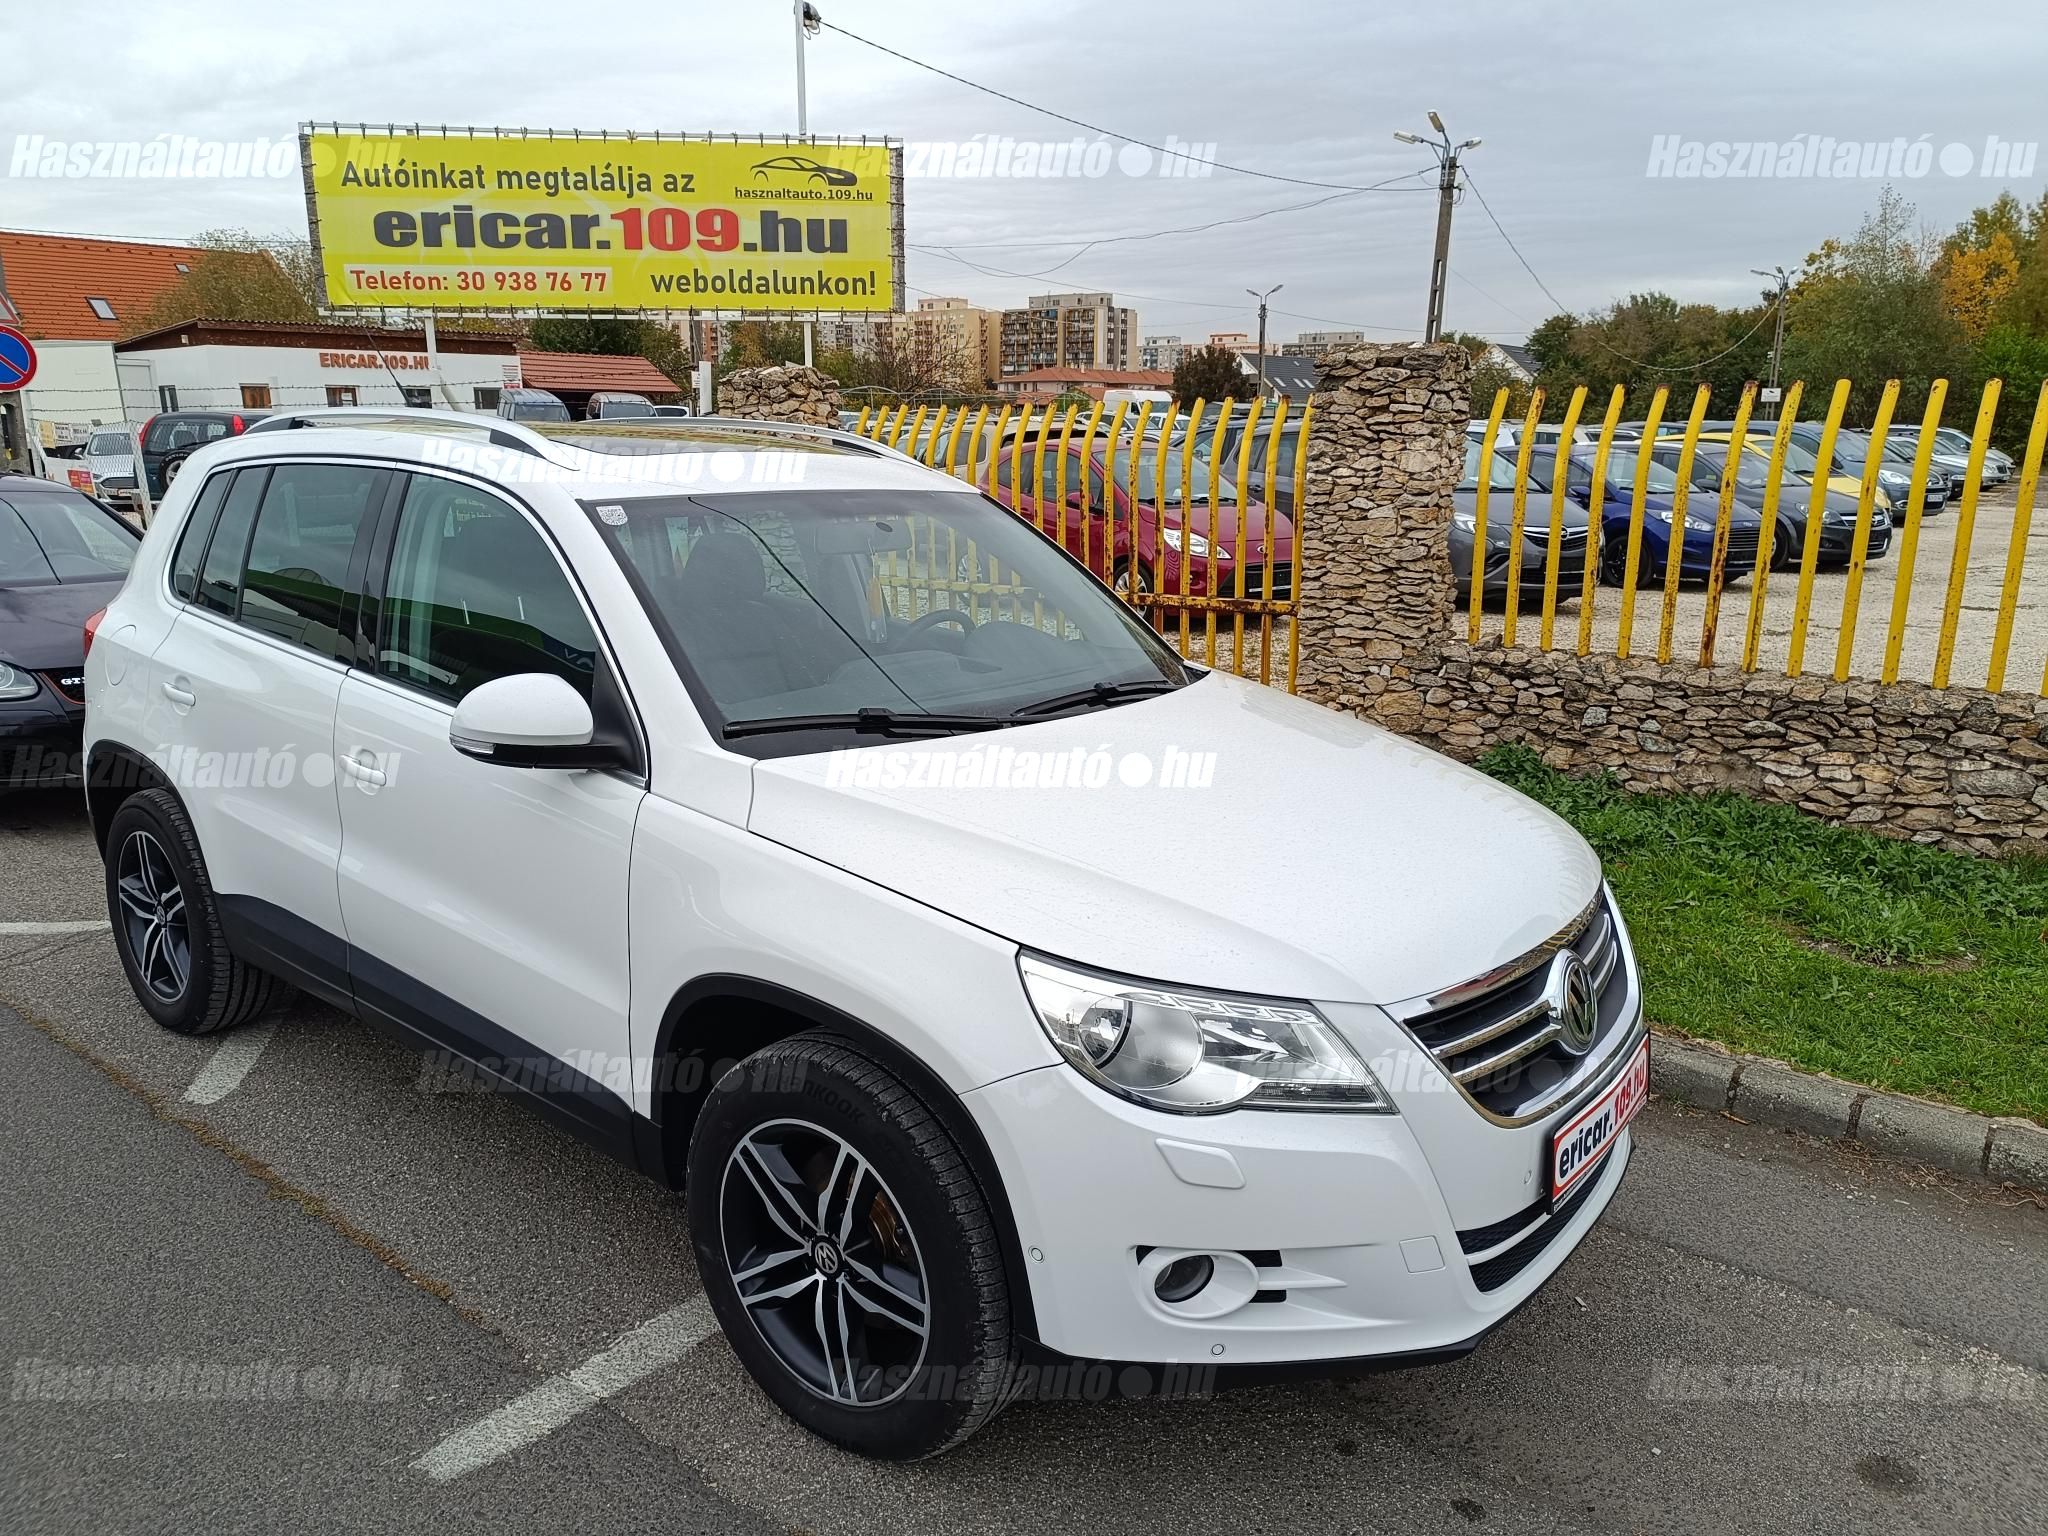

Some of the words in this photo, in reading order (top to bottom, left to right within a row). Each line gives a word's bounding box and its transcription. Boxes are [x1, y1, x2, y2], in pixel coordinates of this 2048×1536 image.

[341, 158, 485, 188] Autóinkat
[497, 162, 652, 198] megtalálja
[663, 173, 695, 193] az
[735, 186, 873, 201] hasznaltauto.109.hu
[373, 204, 848, 253] ericar.109.hu
[350, 270, 449, 290] Telefon:
[456, 271, 485, 291] 30
[494, 271, 537, 292] 938
[546, 272, 572, 292] 76
[580, 272, 607, 292] 77
[651, 268, 876, 296] weboldalunkon!
[1559, 1057, 1646, 1180] ericar.109.hu
